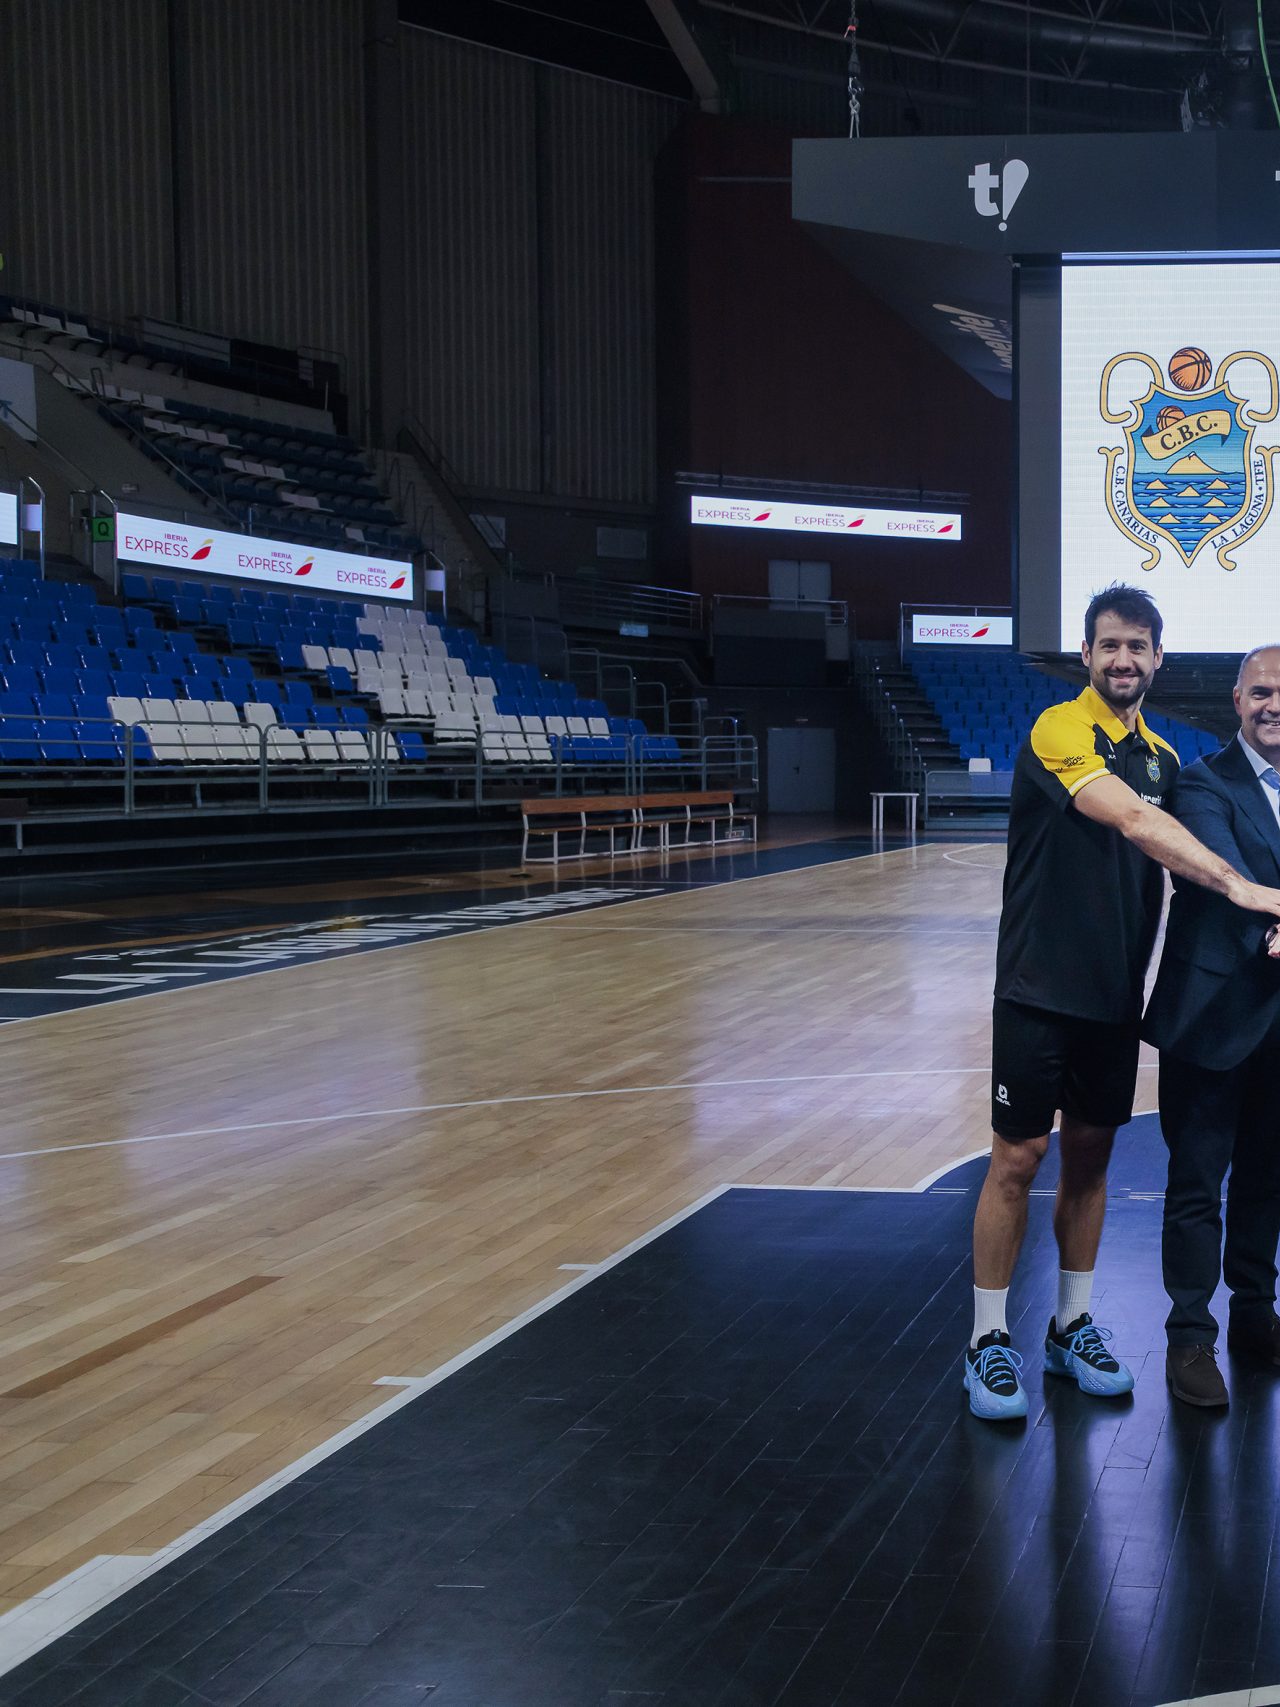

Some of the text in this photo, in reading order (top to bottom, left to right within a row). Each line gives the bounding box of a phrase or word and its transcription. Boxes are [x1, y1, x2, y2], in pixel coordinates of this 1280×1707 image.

[697, 509, 751, 521] EXPRESS
[794, 515, 846, 528] EXPRESS
[1115, 489, 1159, 544] CANARIAS
[1211, 535, 1229, 550] LA
[1231, 493, 1264, 537] LAGUNA
[97, 522, 110, 537] Q
[887, 521, 936, 534] EXPRESS
[164, 533, 188, 543] IBERIA
[125, 535, 190, 559] EXPRESS
[271, 551, 293, 560] IBERIA
[238, 554, 293, 575] EXPRESS
[337, 570, 388, 589] EXPRESS
[919, 628, 970, 638] EXPRESS
[132, 923, 476, 968] LAGUNA
